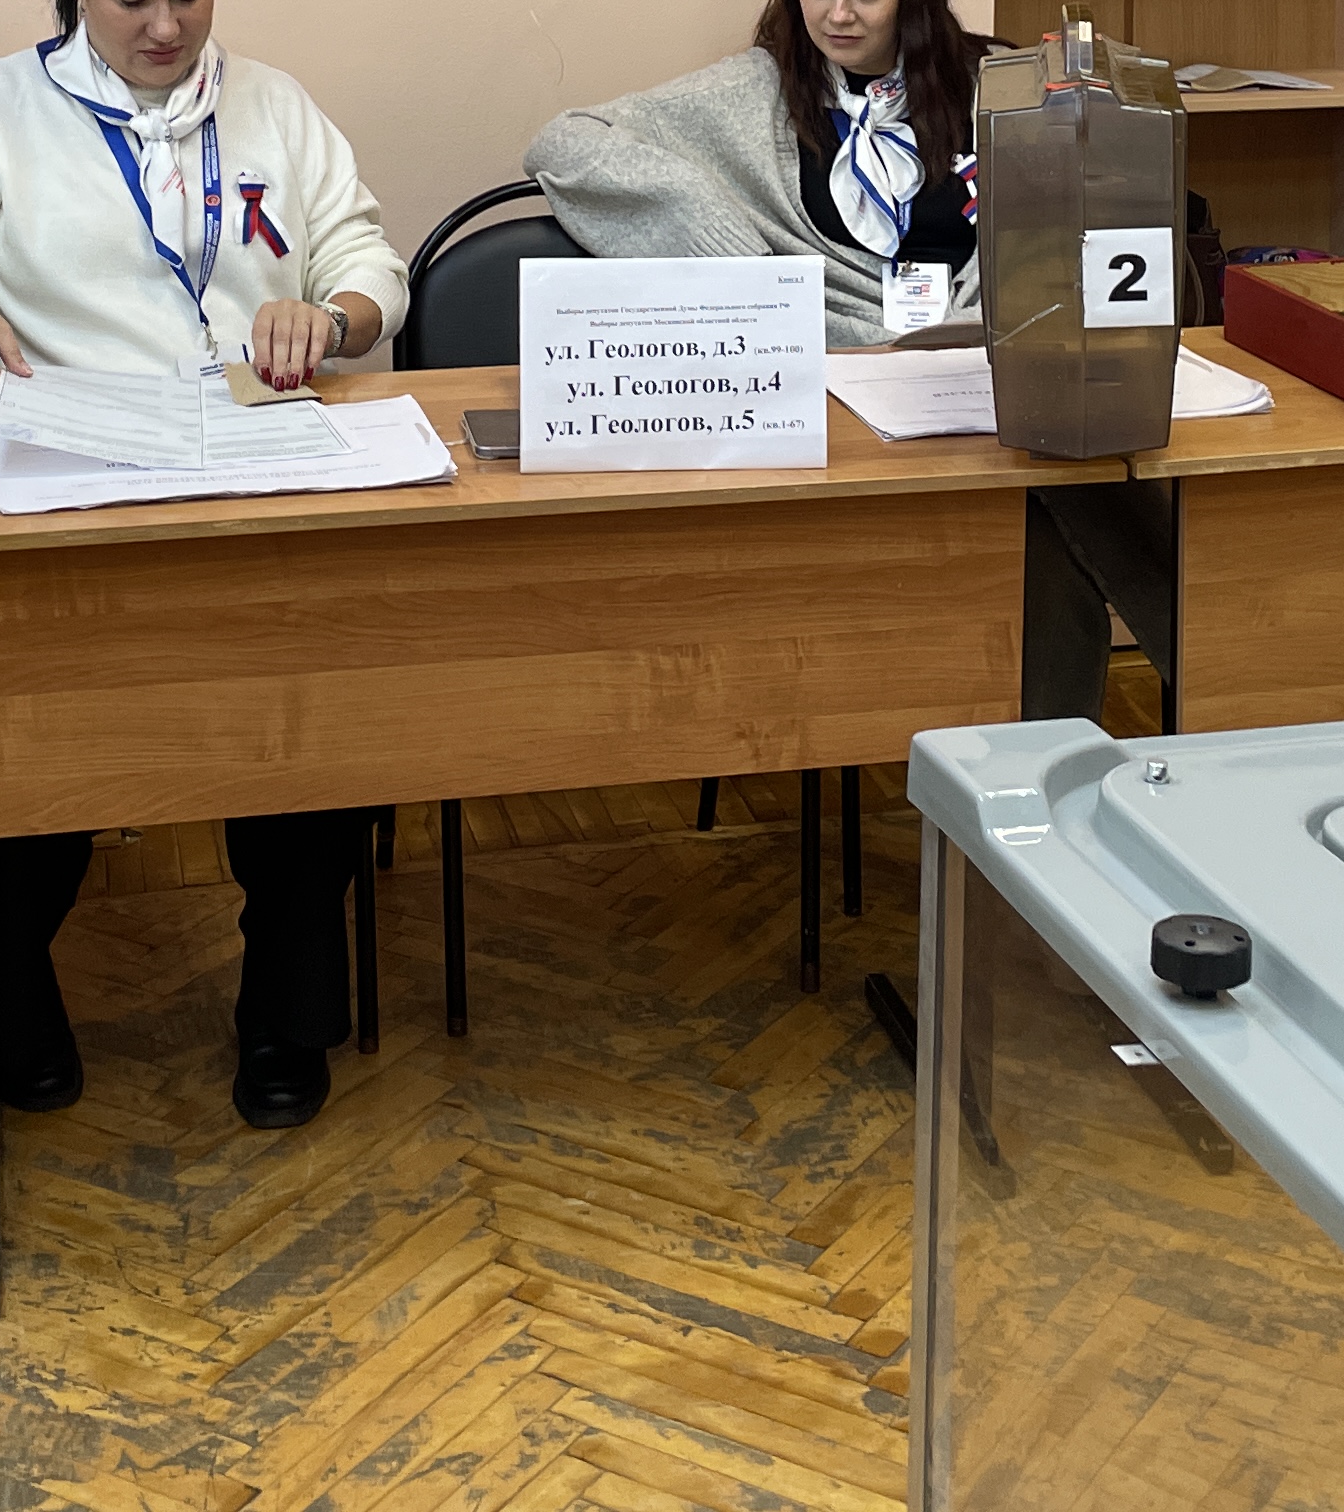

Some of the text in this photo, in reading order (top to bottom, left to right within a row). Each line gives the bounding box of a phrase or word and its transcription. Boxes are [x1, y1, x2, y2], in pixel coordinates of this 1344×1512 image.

[1107, 253, 1149, 302] 2
[544, 344, 579, 366] ул.
[587, 338, 707, 360] Геологов,
[712, 335, 746, 358] д.3
[567, 370, 782, 403] ул. Геологов, д.4
[545, 418, 582, 442] ул.
[590, 414, 713, 436] Геологов,
[719, 409, 755, 432] д.5
